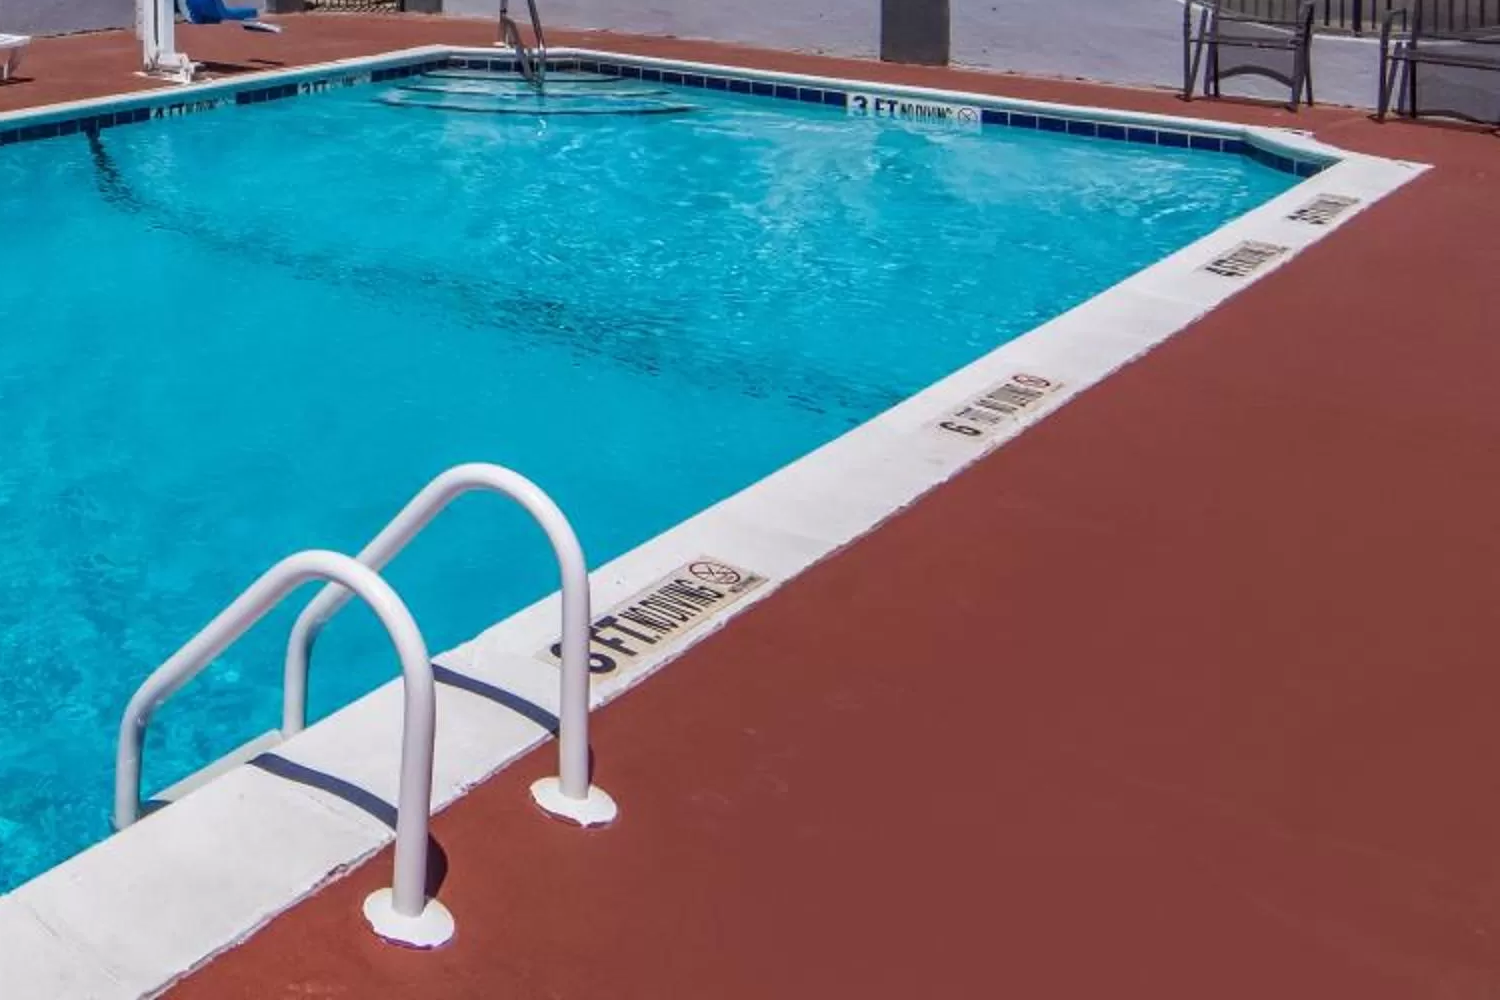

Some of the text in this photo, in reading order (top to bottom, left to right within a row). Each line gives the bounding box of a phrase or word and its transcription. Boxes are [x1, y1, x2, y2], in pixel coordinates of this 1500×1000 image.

[852, 94, 869, 117] 3
[874, 97, 899, 118] FT
[638, 577, 726, 622] DIVING
